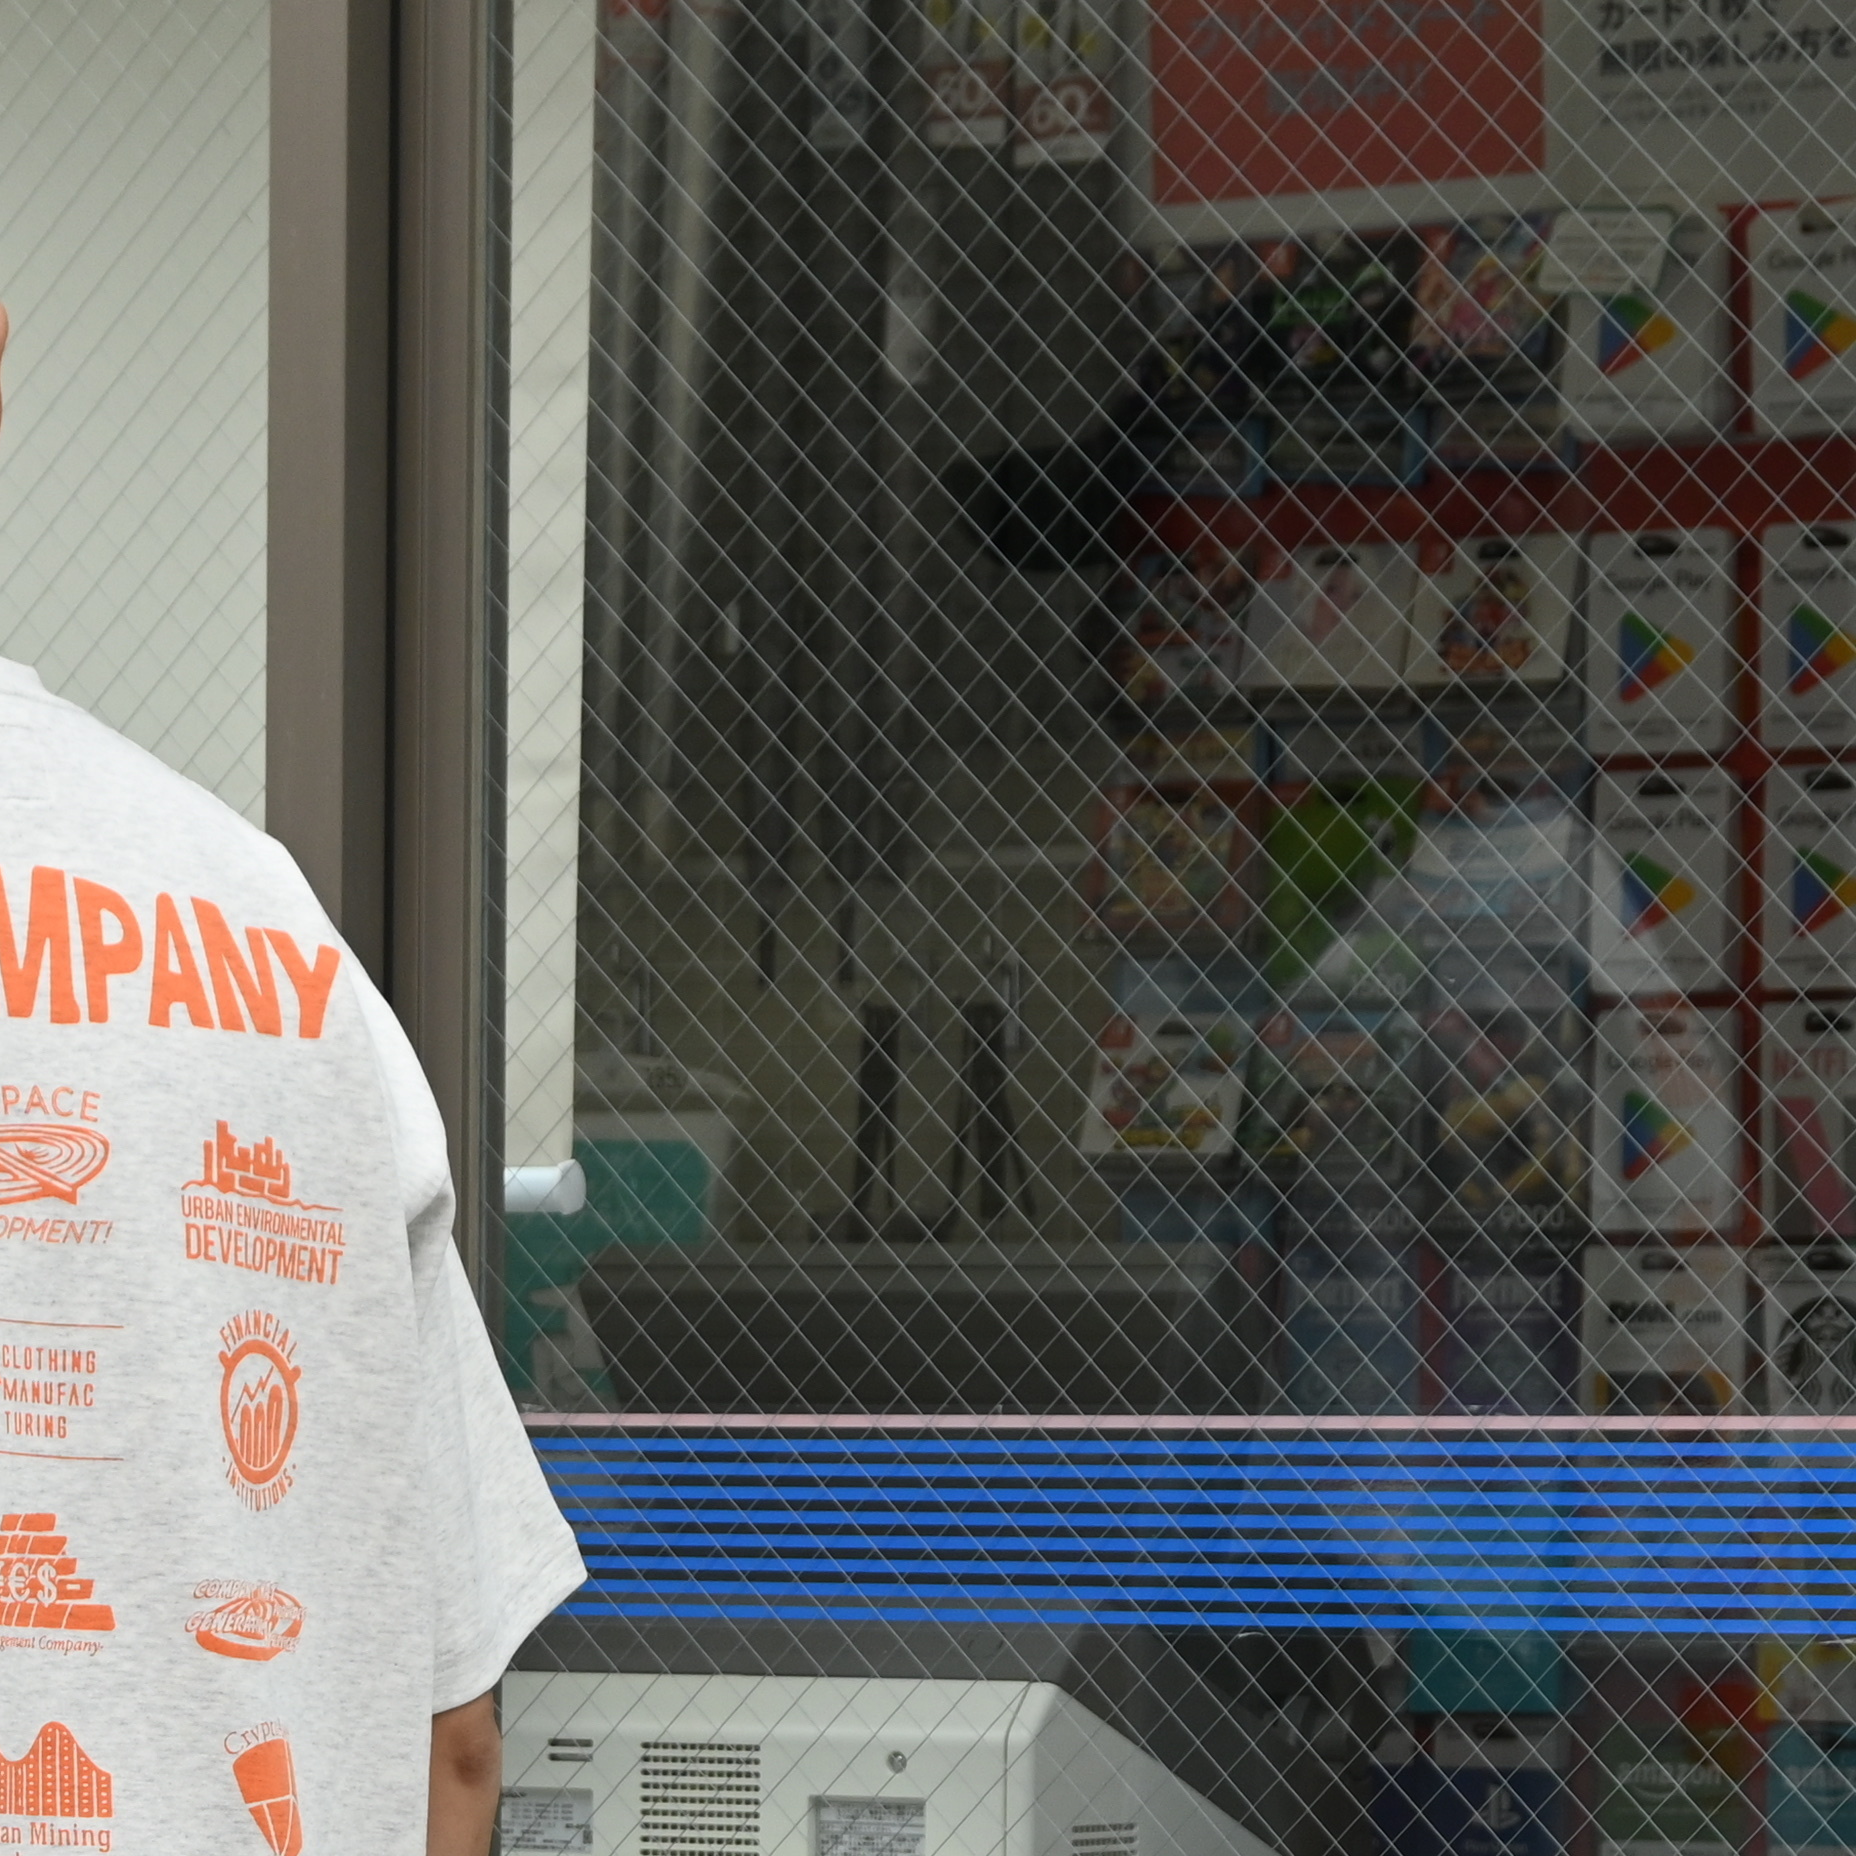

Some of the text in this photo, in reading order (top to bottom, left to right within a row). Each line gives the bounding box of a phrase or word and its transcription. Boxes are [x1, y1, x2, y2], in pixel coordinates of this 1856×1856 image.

[180, 1194, 348, 1247] URBAN ENVIRONMENTAL
[182, 1220, 348, 1288] DEVELOPMENT
[218, 1309, 298, 1364] FINANCIAL
[1, 1344, 98, 1374] CLOTHING
[2, 1379, 96, 1407] MANUFAC
[5, 1411, 68, 1439] TURING
[30, 1819, 112, 1853] Mining
